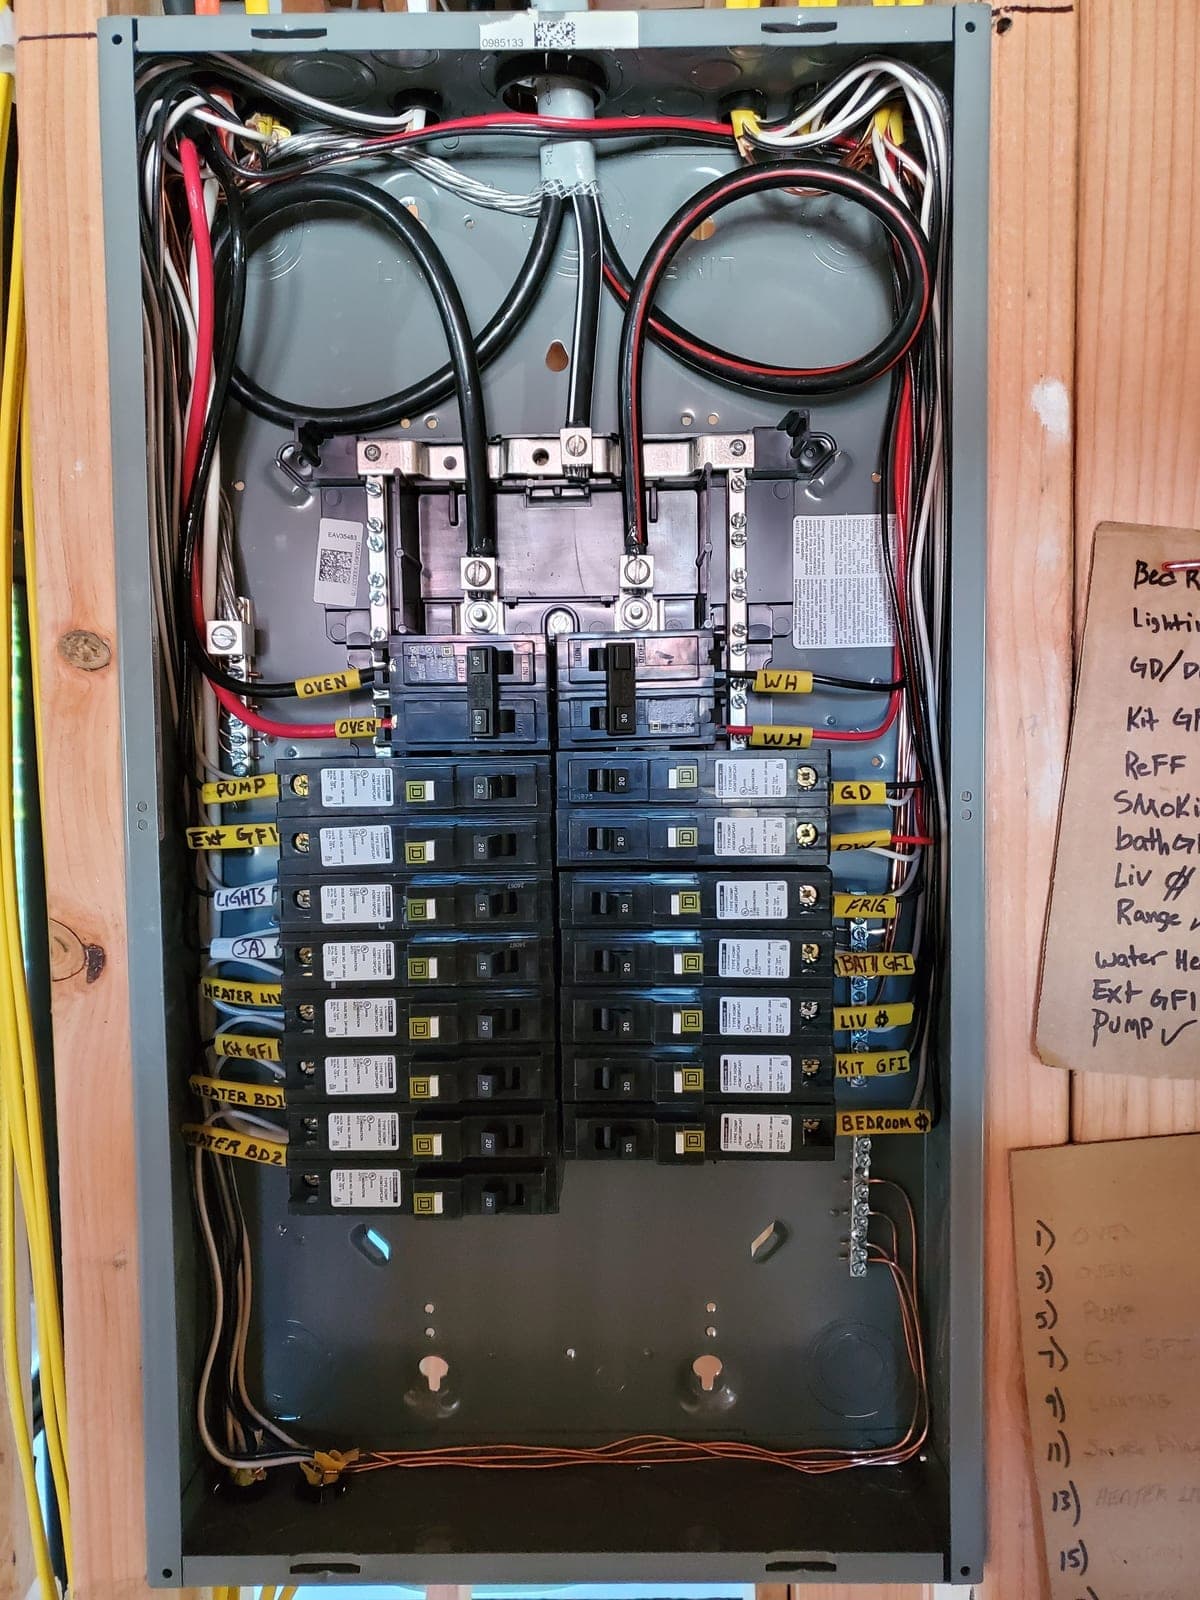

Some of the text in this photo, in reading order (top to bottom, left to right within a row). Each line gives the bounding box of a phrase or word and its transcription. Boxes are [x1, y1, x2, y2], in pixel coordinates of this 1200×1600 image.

[482, 38, 524, 48] 0985133
[303, 674, 347, 695] OVEN
[763, 672, 798, 691] WH
[474, 715, 482, 725] 50
[620, 713, 628, 723] 30
[1127, 706, 1159, 732] Kit
[339, 719, 376, 735] OVEN
[763, 733, 802, 746] WH
[216, 777, 266, 798] PUMP
[477, 784, 484, 794] 20
[618, 776, 625, 786] 20
[840, 785, 872, 801] GD
[478, 844, 485, 853] 20
[617, 836, 624, 846] 20
[1115, 862, 1152, 888] Liv
[216, 887, 267, 907] LIGHTS
[844, 897, 889, 914] FRIG
[479, 903, 486, 911] 15
[622, 903, 629, 913] 20
[1117, 898, 1181, 932] Range
[480, 962, 487, 970] 15
[624, 963, 631, 972] 20
[883, 952, 914, 972] GFI
[203, 983, 255, 1004] HEATER
[1092, 979, 1143, 1004] Ext
[482, 1021, 489, 1031] 20
[623, 1022, 630, 1031] 20
[840, 1013, 867, 1028] LIV
[838, 1055, 908, 1074] KIT GFI
[192, 1082, 248, 1103] HEATER
[482, 1081, 489, 1091] 20
[624, 1081, 630, 1091] 20
[841, 1115, 912, 1133] BEDROOM
[485, 1139, 492, 1149] 20
[626, 1143, 633, 1152] 20
[245, 1144, 283, 1165] BD2
[486, 1198, 493, 1207] 20
[1036, 1219, 1056, 1256] 1)
[1035, 1264, 1054, 1294] 3)
[1035, 1299, 1058, 1330] 5)
[1038, 1336, 1069, 1372] 7)
[1045, 1386, 1066, 1423] 9)
[1047, 1429, 1071, 1468] 11)
[1052, 1480, 1081, 1528] 13)
[1060, 1539, 1089, 1577] 15)
